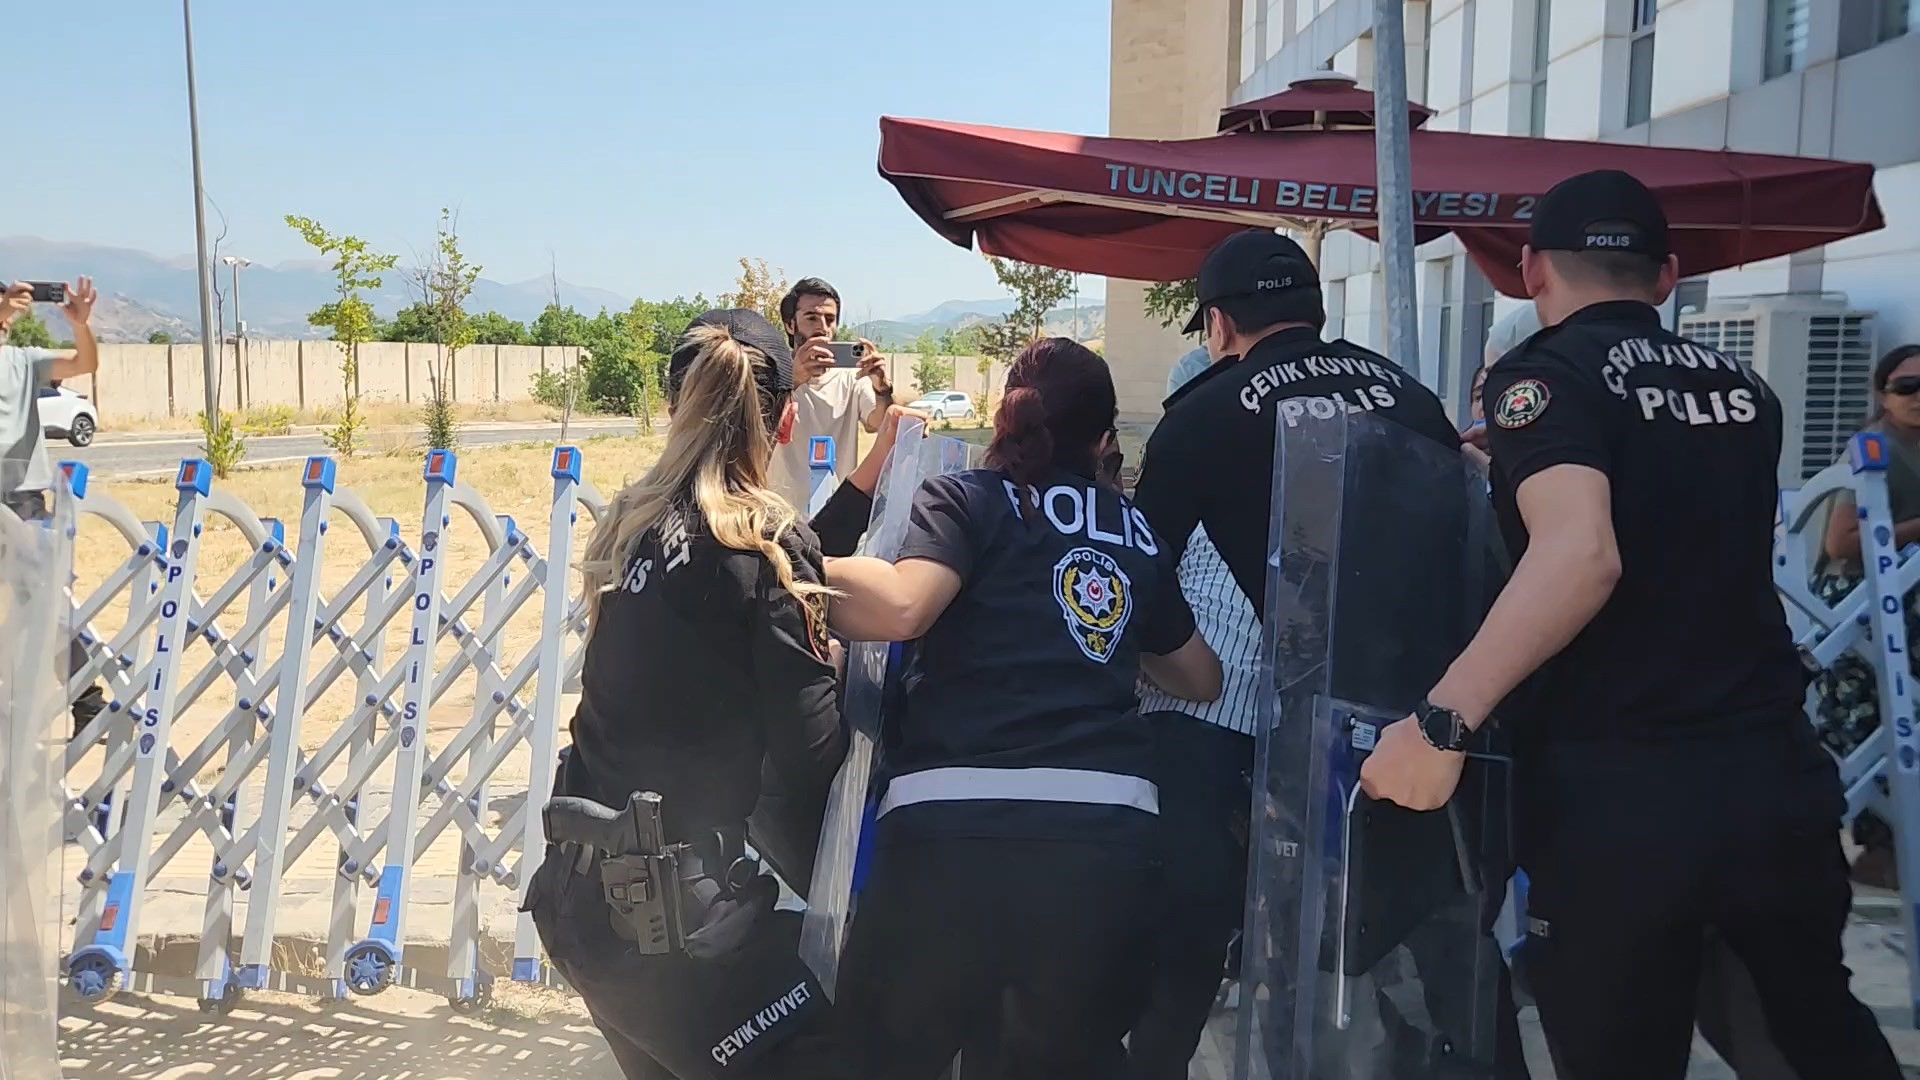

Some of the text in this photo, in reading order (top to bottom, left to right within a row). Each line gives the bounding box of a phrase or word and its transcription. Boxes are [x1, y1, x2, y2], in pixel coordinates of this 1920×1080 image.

[1276, 180, 1499, 218] BELEYESI
[1303, 355, 1404, 388] KUVVET
[755, 981, 812, 1032] KUVVET
